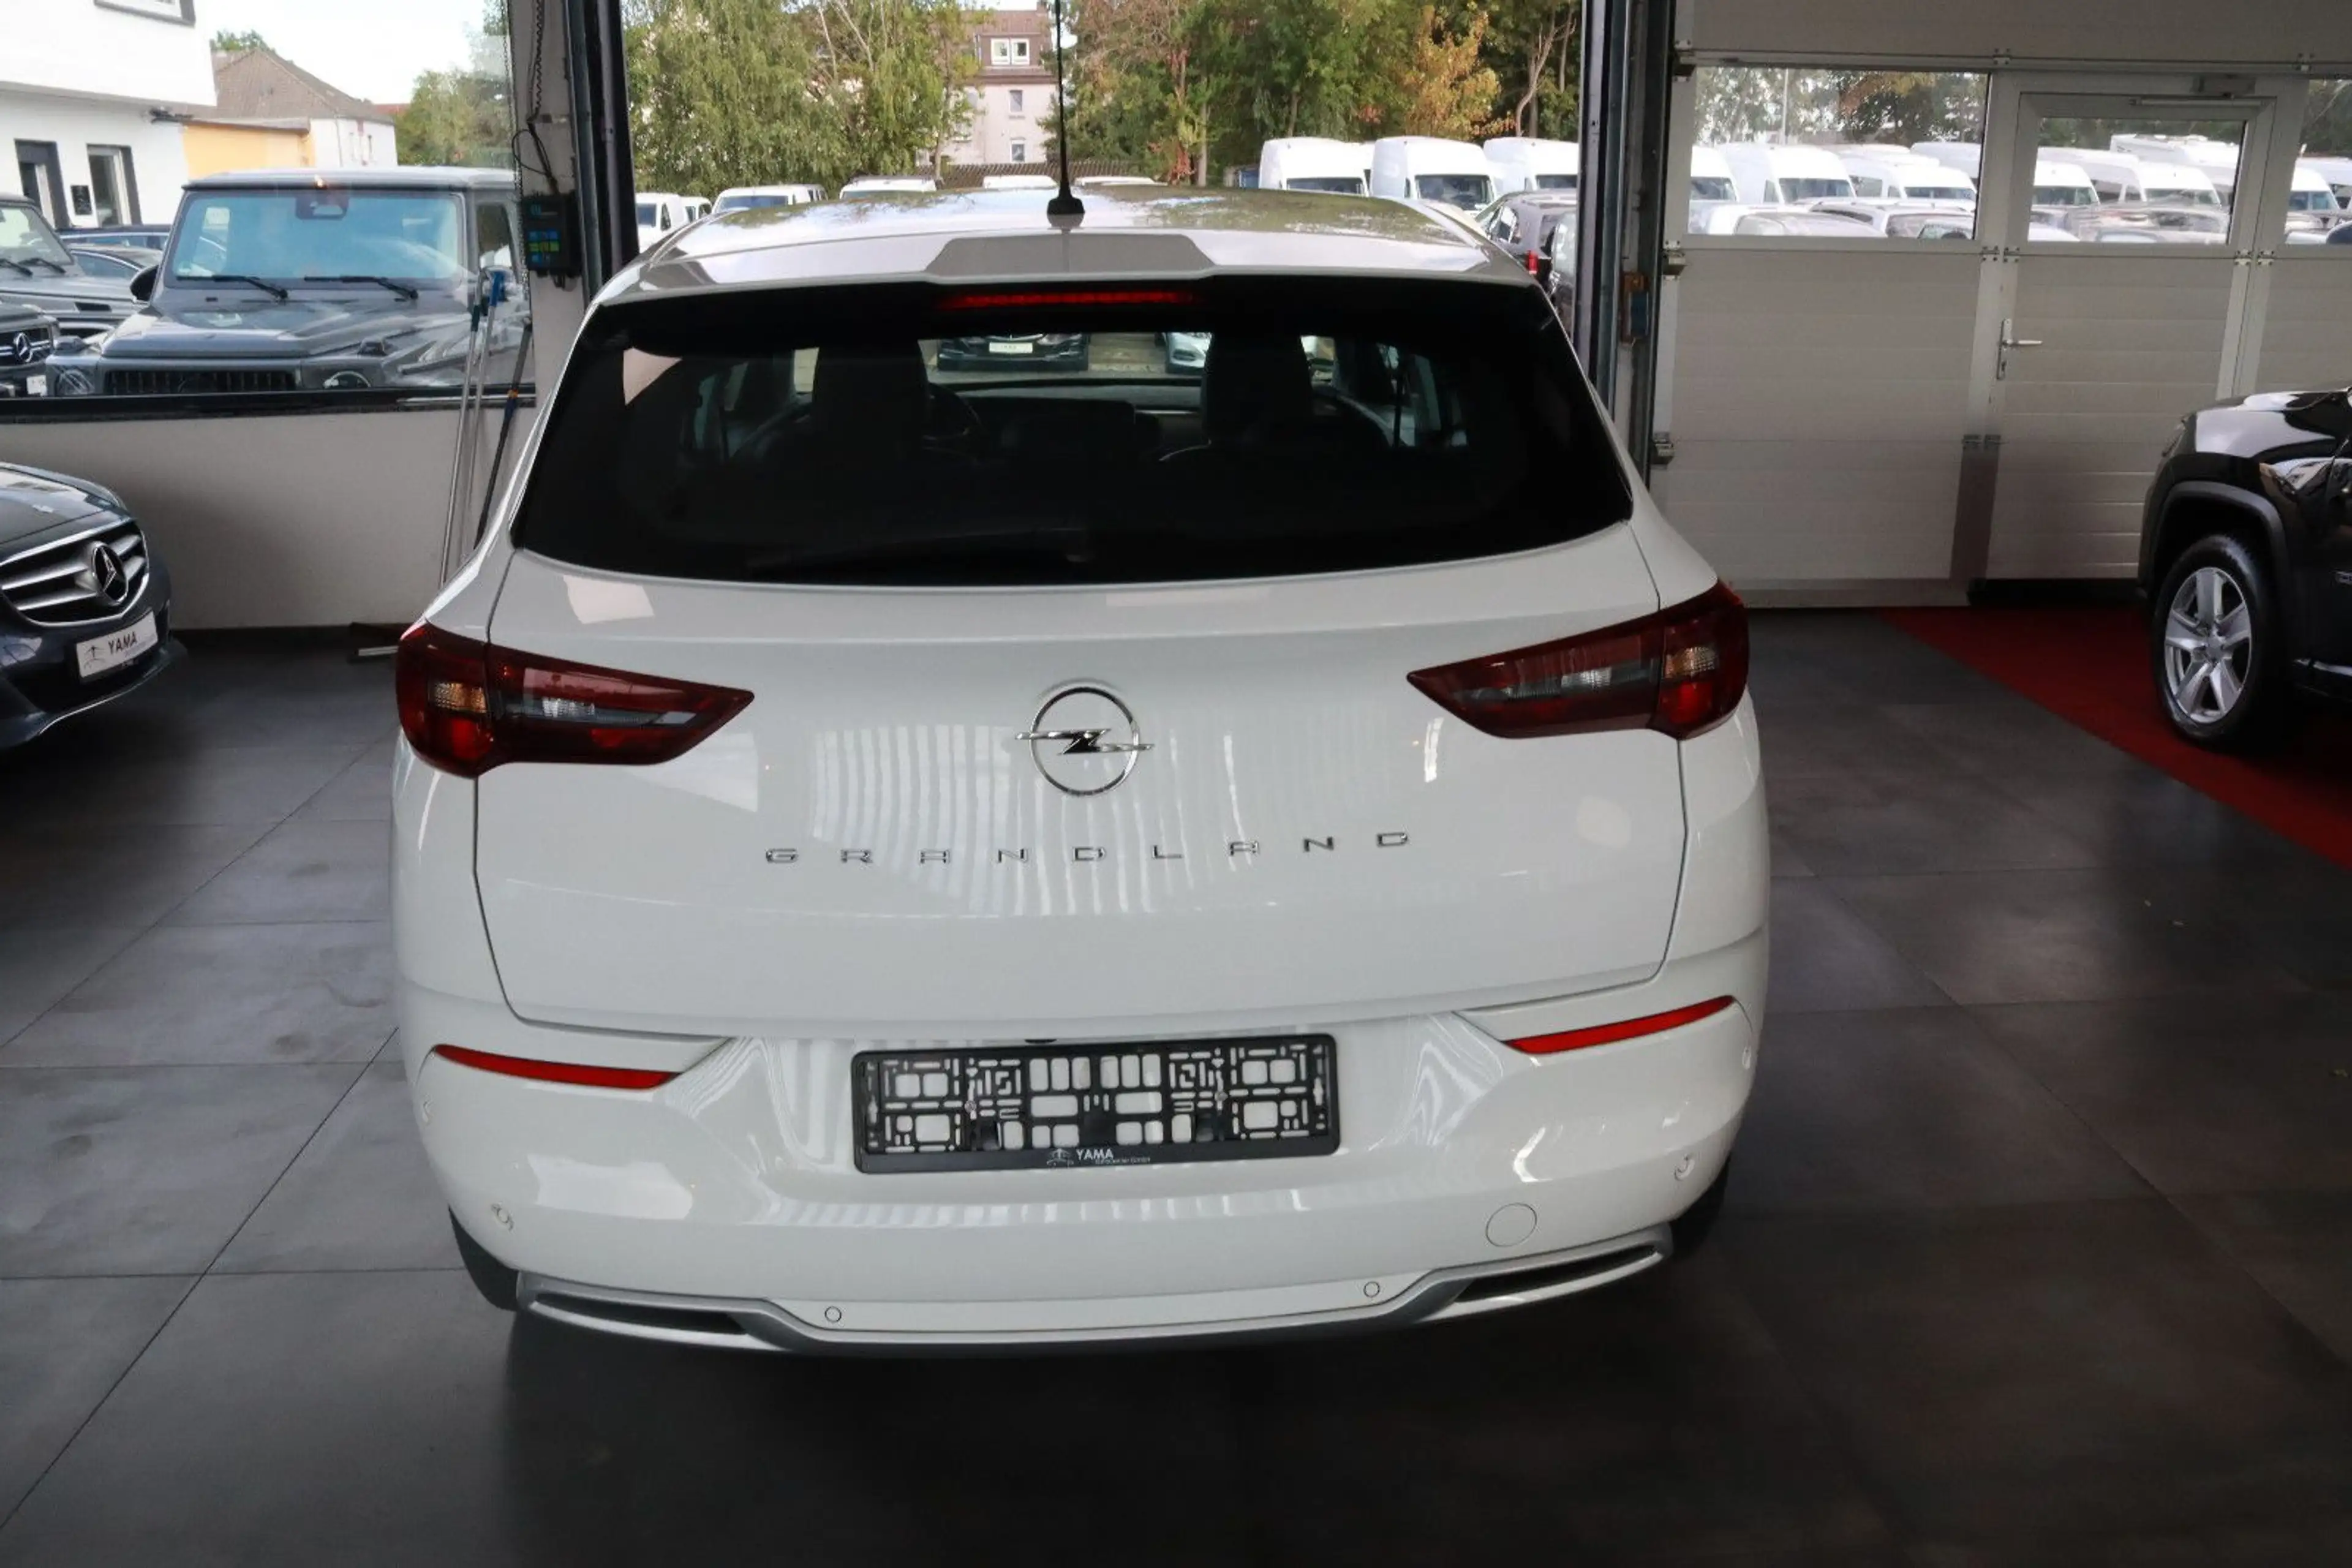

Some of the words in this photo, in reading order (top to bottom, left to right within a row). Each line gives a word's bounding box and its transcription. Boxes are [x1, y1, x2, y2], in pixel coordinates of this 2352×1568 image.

[108, 631, 138, 654] YAMA
[765, 832, 1408, 864] GRANDLAND
[1076, 1148, 1114, 1161] YAMA
